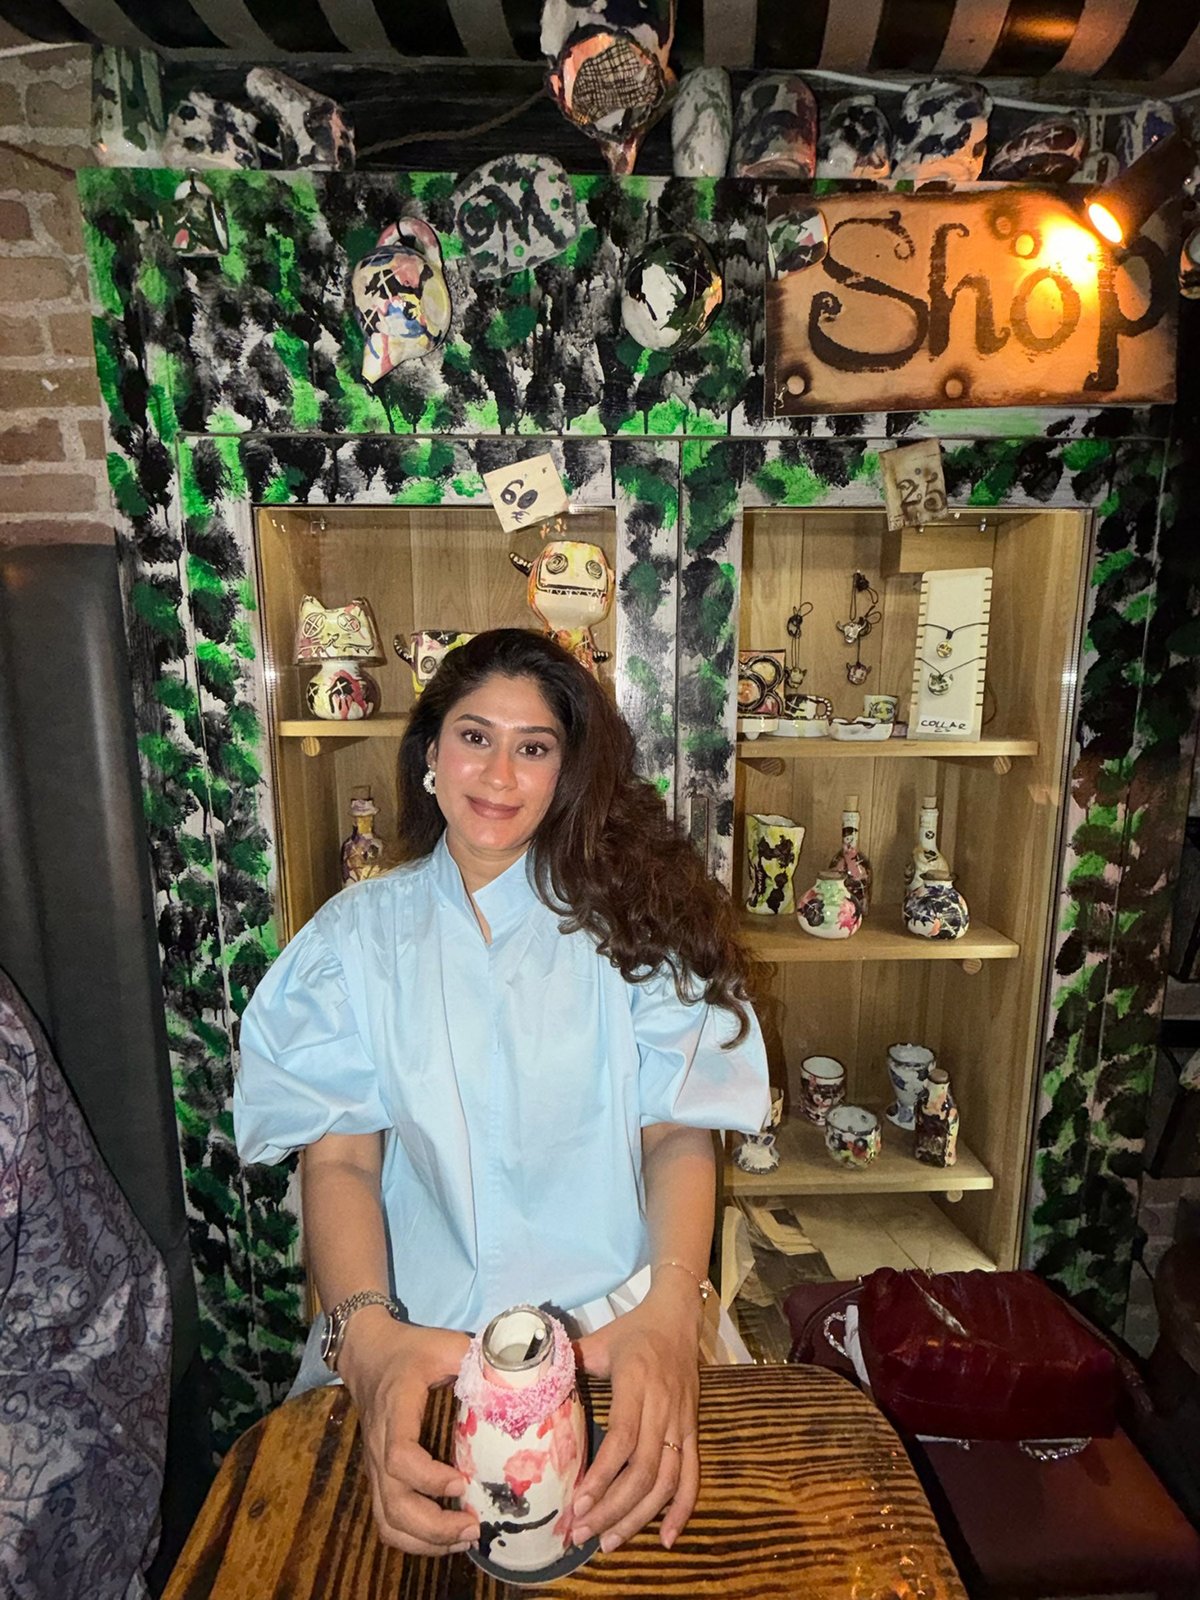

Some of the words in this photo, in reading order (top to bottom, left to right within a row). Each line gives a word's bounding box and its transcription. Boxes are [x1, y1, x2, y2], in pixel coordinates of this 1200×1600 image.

[808, 210, 1166, 392] Shop
[500, 479, 538, 509] 60
[896, 472, 947, 513] 25
[921, 719, 966, 730] COLLAR
